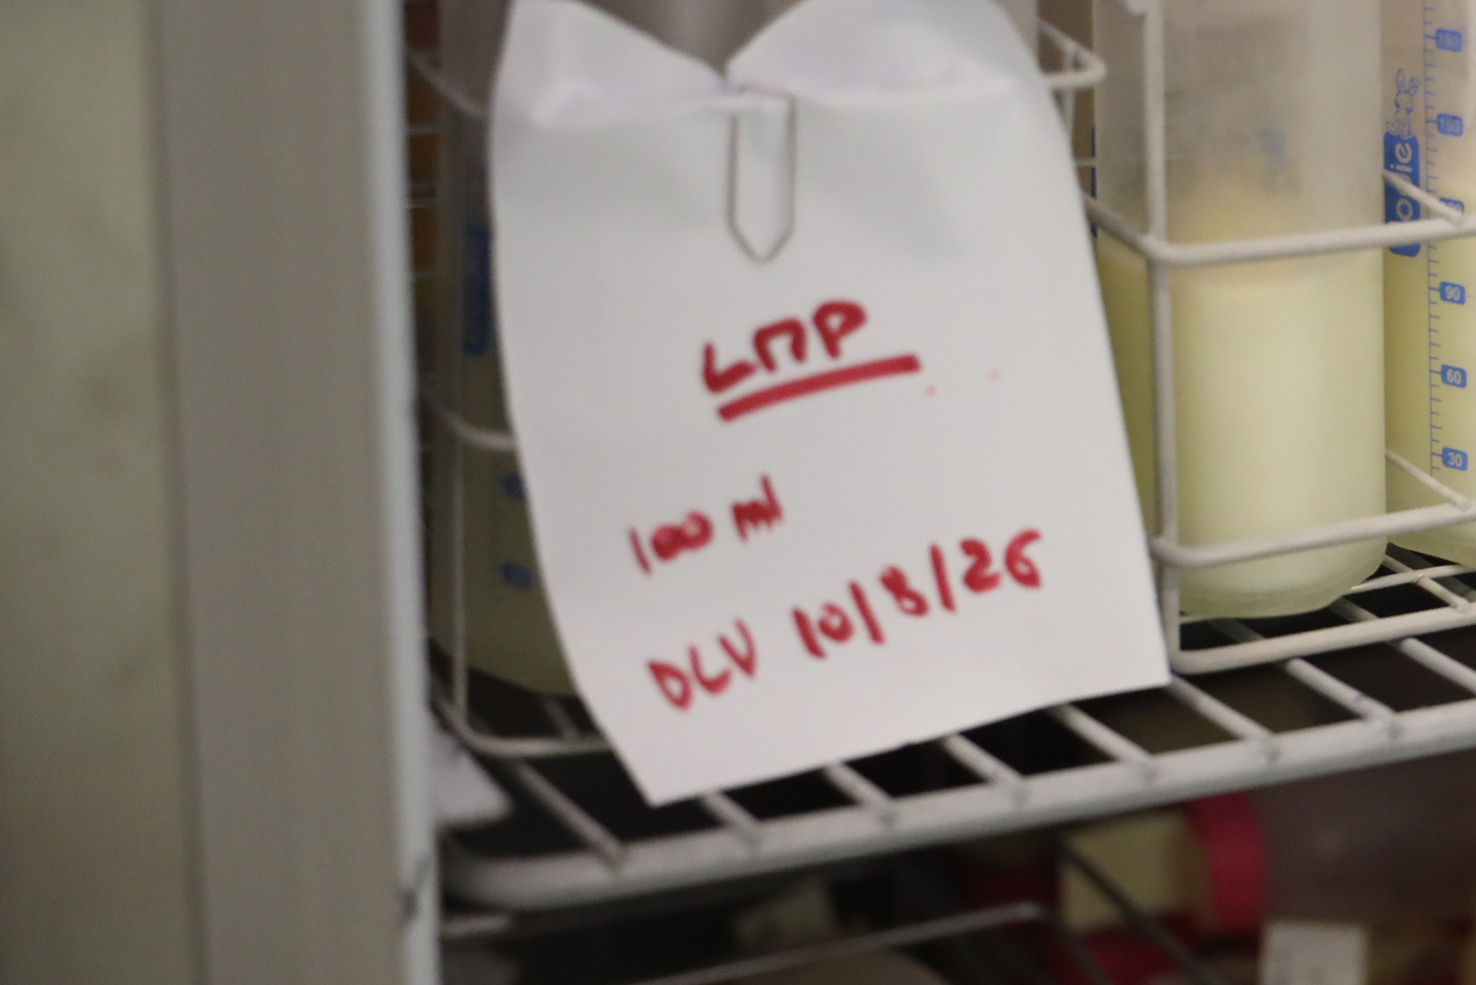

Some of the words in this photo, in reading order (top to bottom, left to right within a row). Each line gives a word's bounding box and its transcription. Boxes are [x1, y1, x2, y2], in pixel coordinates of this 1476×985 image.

[1388, 142, 1414, 244] oie
[1445, 285, 1461, 301] 90
[1446, 368, 1462, 385] 60
[1447, 452, 1463, 468] 30
[629, 509, 714, 575] 100
